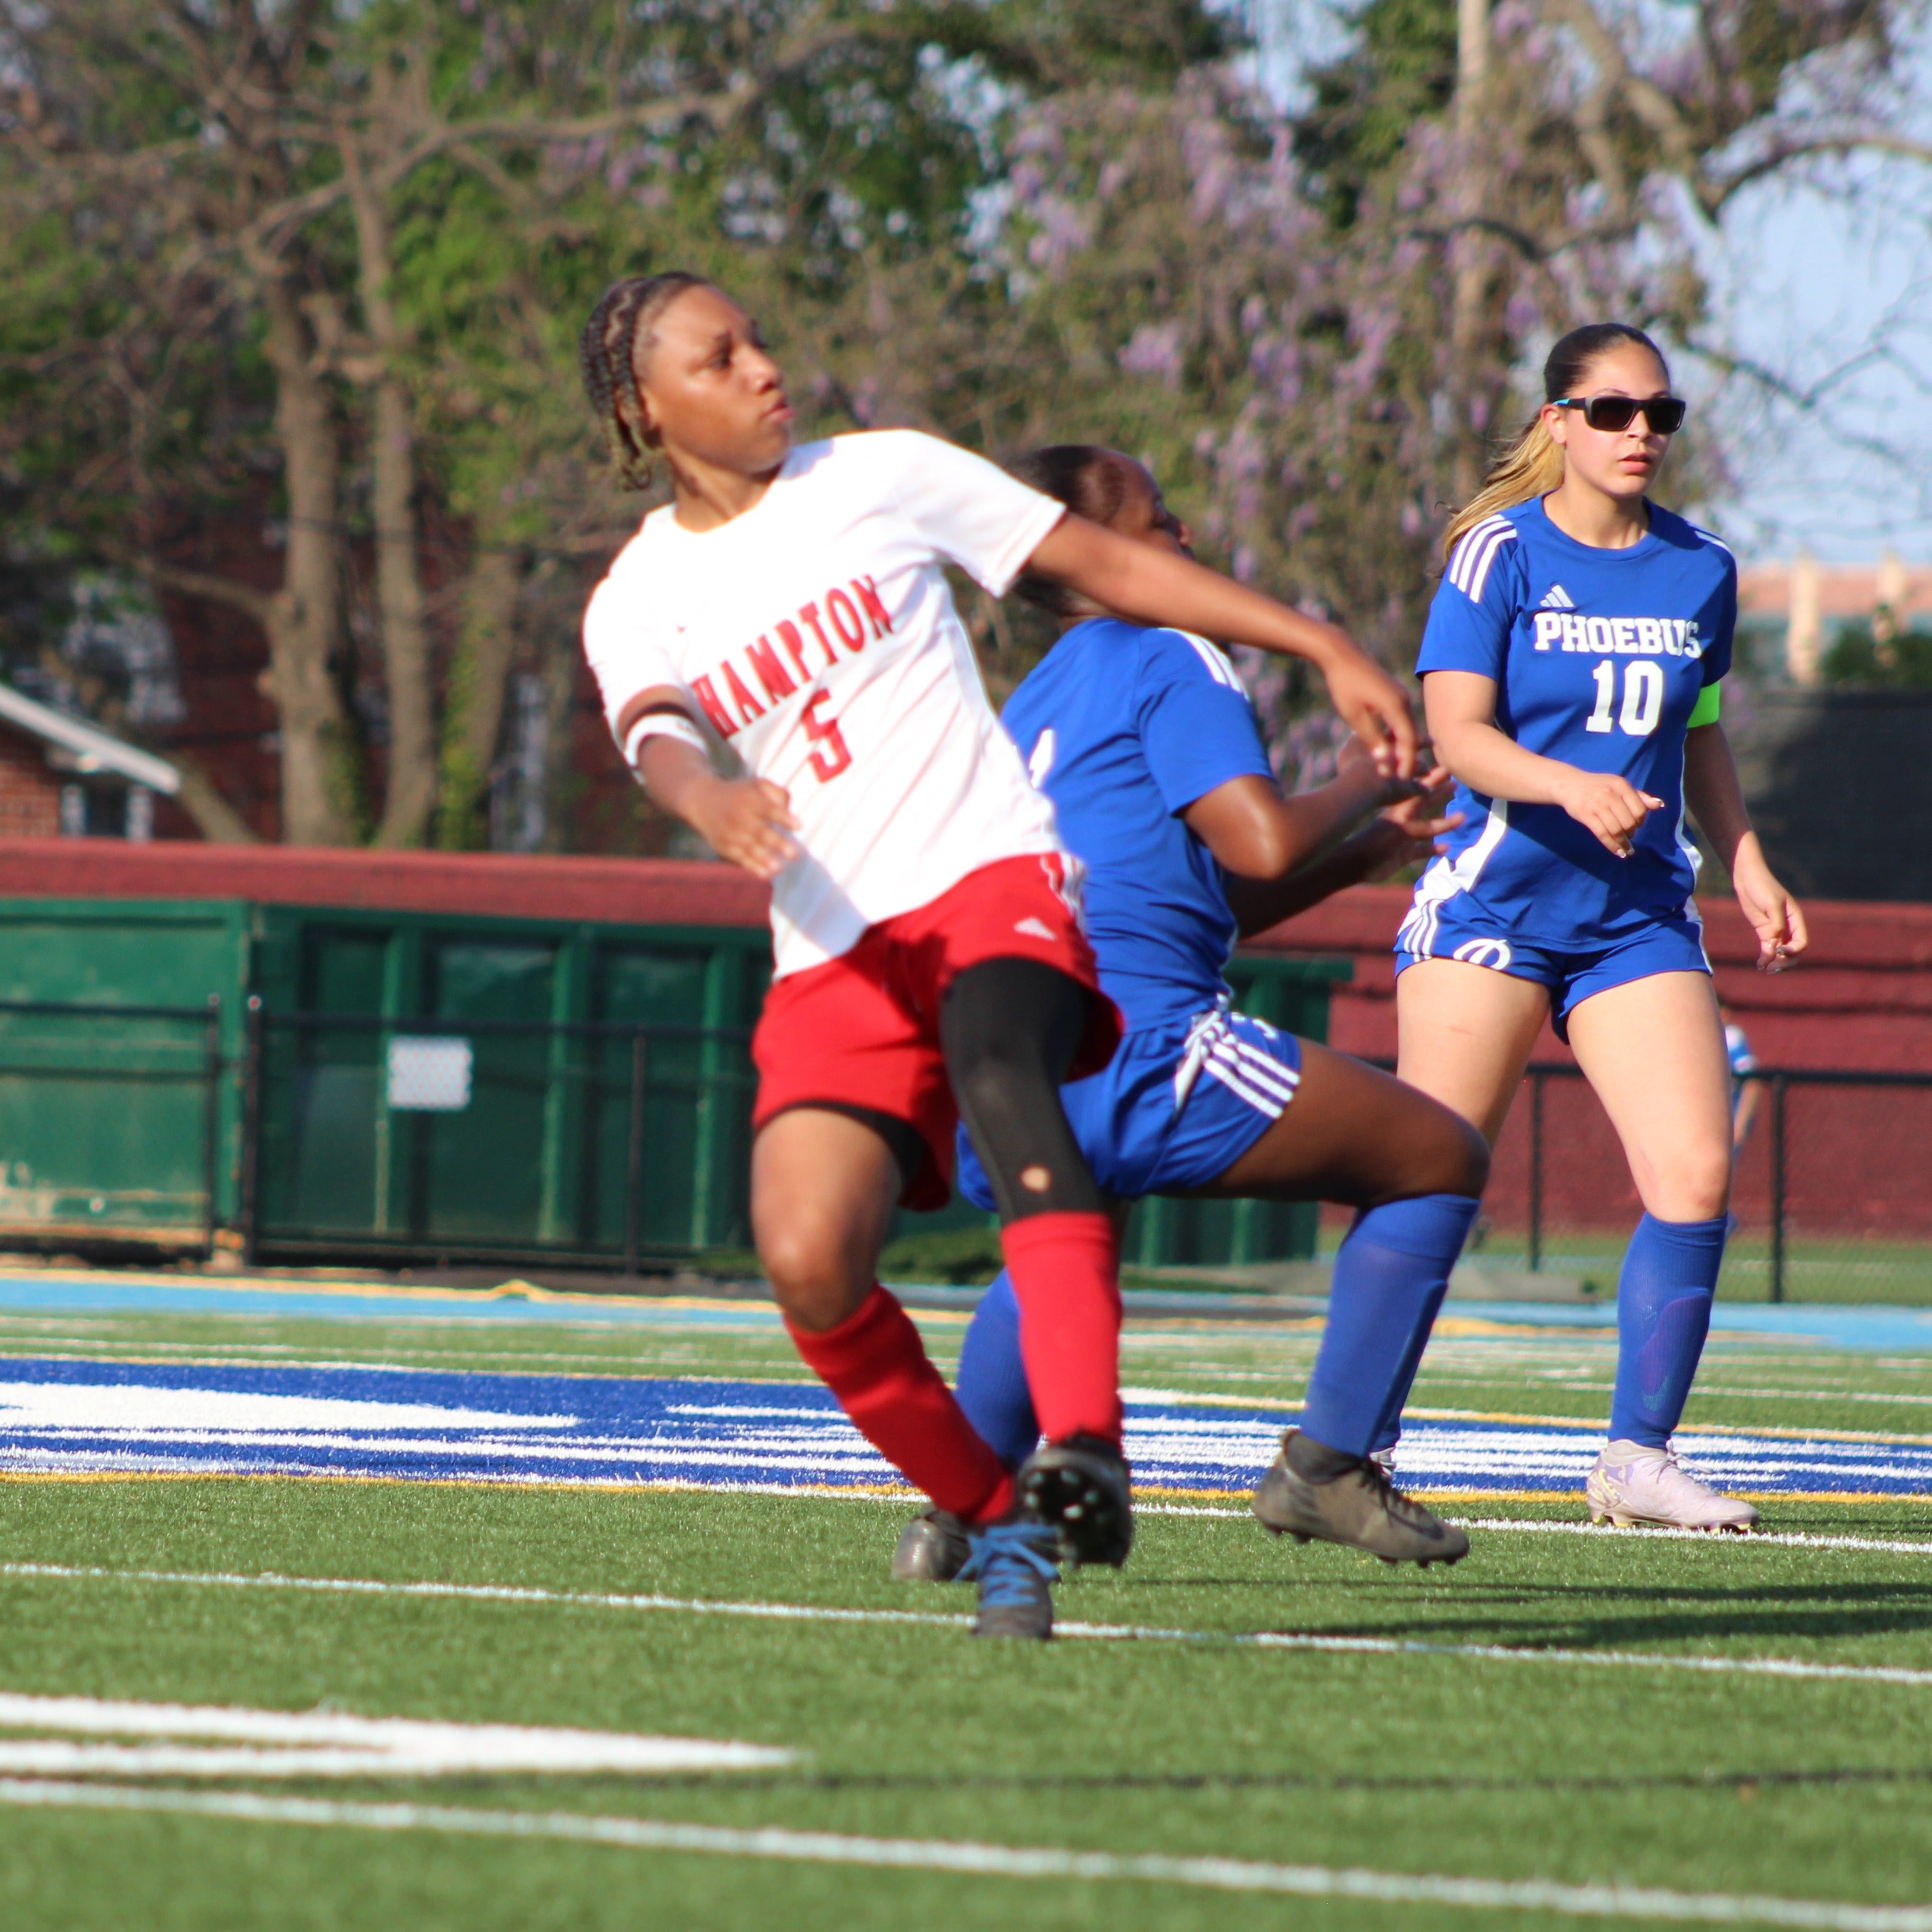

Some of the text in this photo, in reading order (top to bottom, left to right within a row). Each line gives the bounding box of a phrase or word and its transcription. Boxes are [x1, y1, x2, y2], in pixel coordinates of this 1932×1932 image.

[690, 574, 893, 740] HAMPTON
[1534, 612, 1702, 659] PHOEBUS
[801, 689, 852, 783] 5
[1586, 660, 1663, 735] 10
